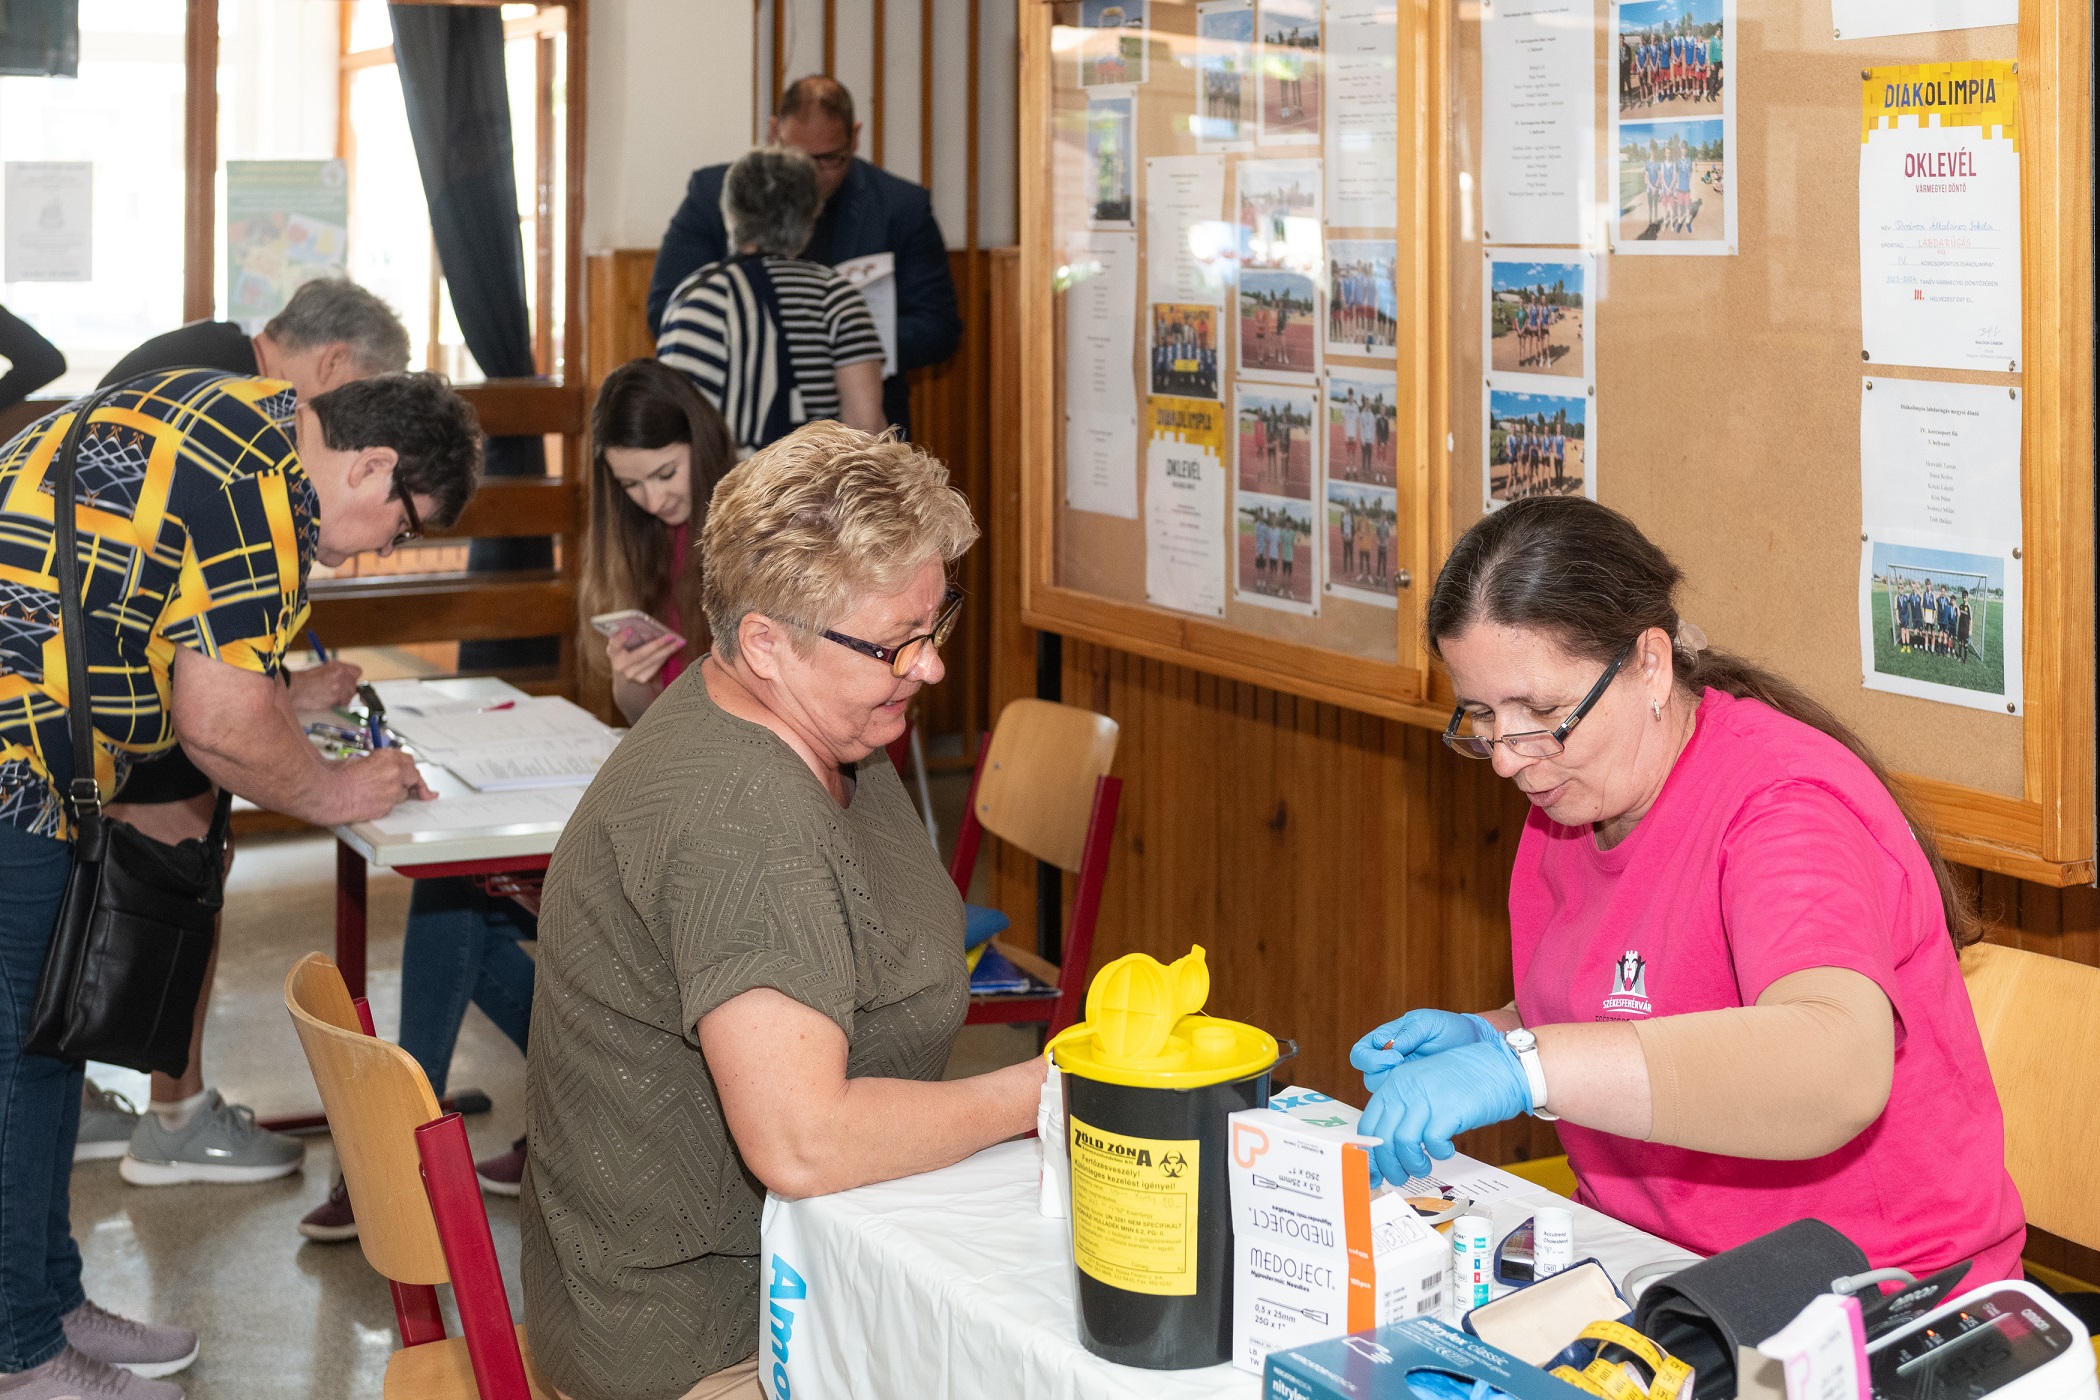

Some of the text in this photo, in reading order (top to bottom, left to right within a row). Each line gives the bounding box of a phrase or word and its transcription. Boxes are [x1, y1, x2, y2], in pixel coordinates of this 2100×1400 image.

[1904, 147, 1977, 178] OKLEVÉL
[1915, 183, 1947, 193] VÁRMEGYEI
[1917, 234, 1971, 248] LABDARÚGÁS
[1603, 997, 1652, 1013] SZÉKESFEHÉRVÁR
[1074, 1128, 1152, 1167] ZÖLD ZÓNA
[1075, 1158, 1176, 1191] Különleges kezelést igényel!
[1081, 1154, 1140, 1178] Fertőzésveszély!
[1143, 1221, 1182, 1229] SPECIFIKÁLT
[1271, 1205, 1332, 1227] Hypodermic Needles
[1250, 1270, 1310, 1293] Hypodermic Needles
[1254, 1303, 1266, 1314] 0,5
[1273, 1309, 1296, 1323] 25mm
[1255, 1315, 1269, 1326] 25G
[769, 1252, 807, 1400] Amo
